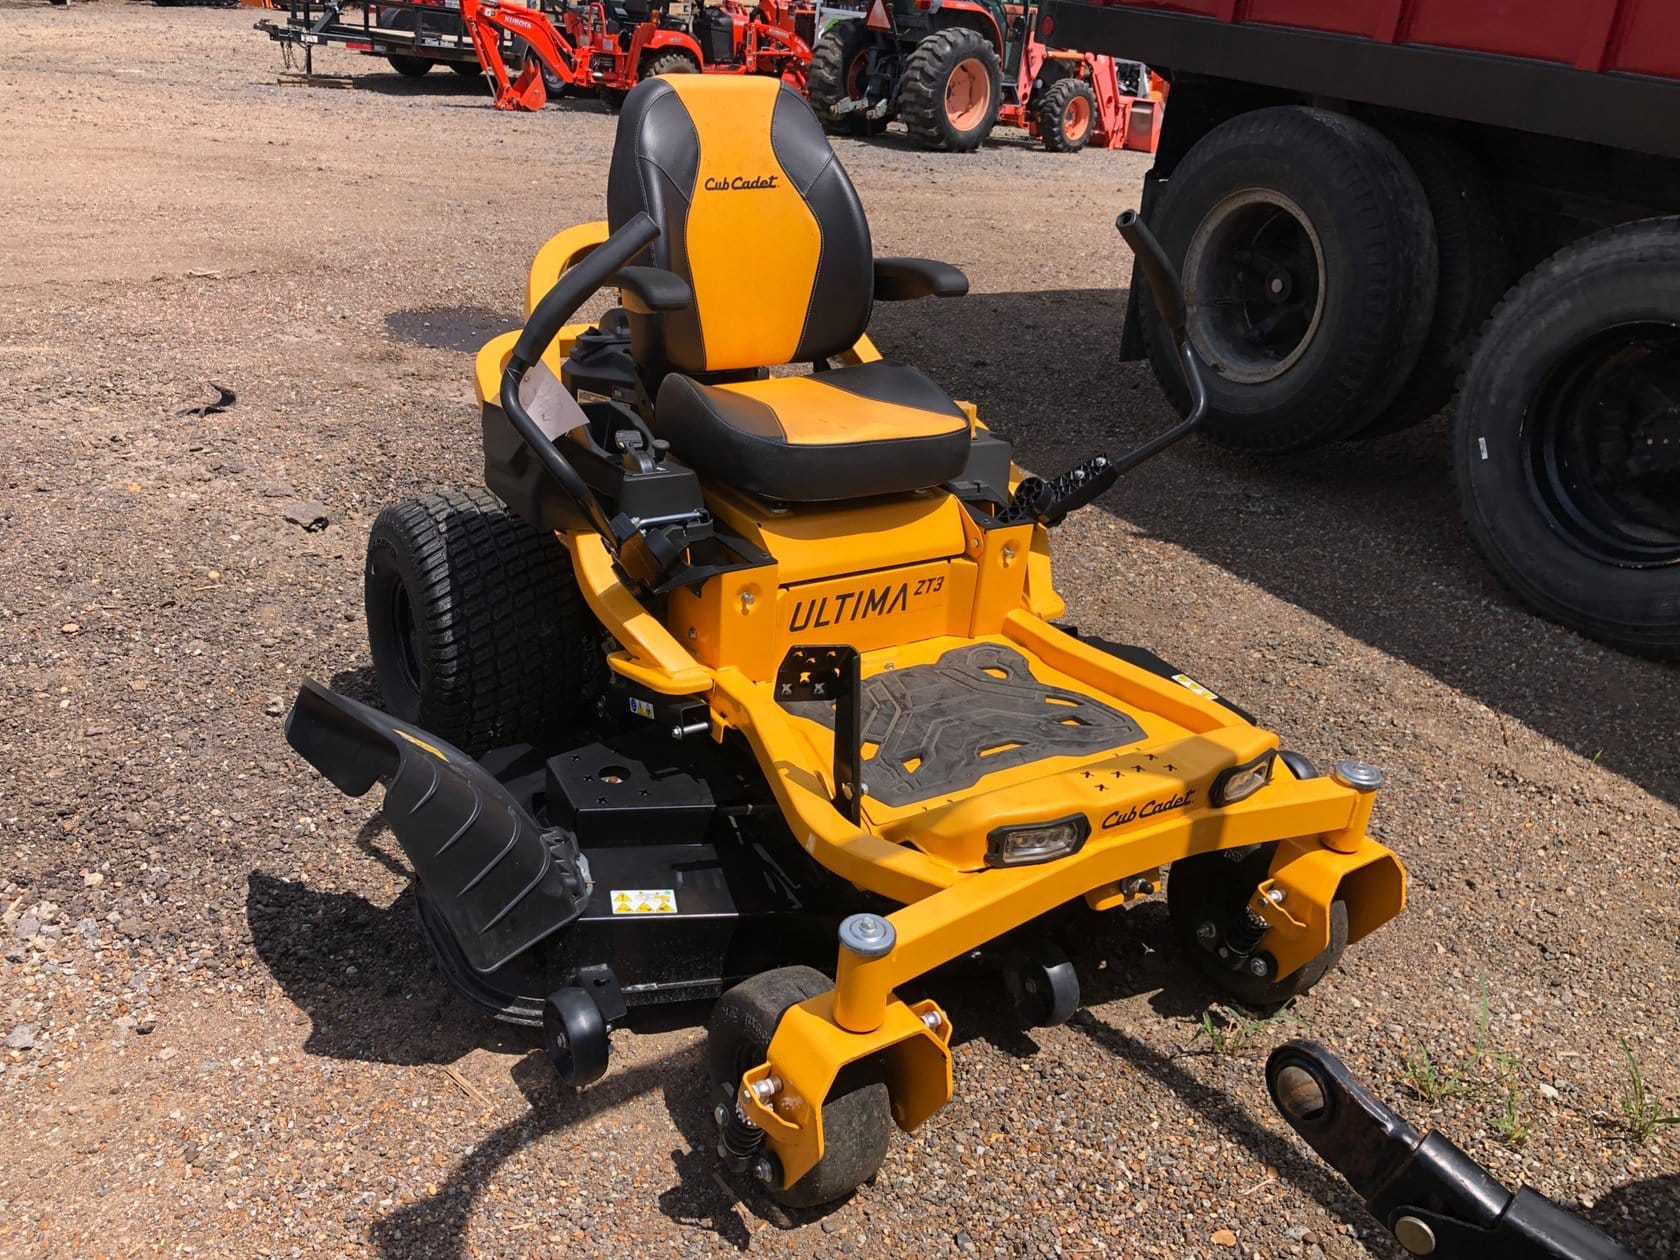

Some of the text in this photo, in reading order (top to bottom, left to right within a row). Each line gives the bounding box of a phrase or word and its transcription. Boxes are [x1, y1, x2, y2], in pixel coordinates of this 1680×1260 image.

[504, 15, 532, 30] KUBOTA
[704, 175, 778, 190] Cub Cadet
[789, 576, 945, 632] ULTIMA ZT3
[1101, 789, 1196, 830] Cub Cadet
